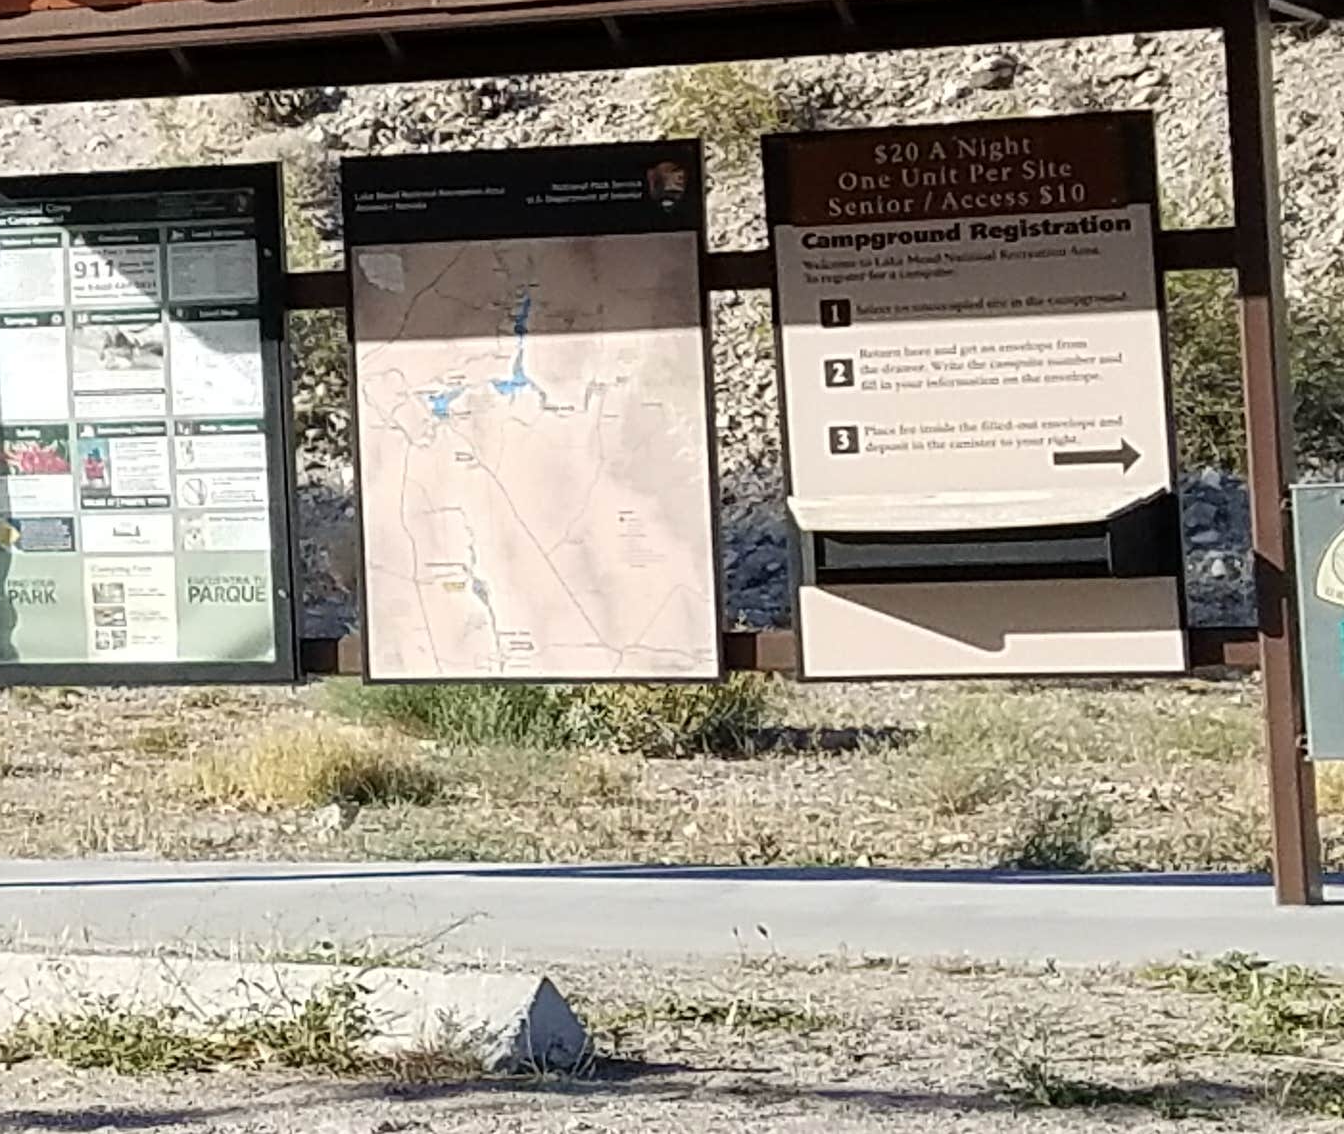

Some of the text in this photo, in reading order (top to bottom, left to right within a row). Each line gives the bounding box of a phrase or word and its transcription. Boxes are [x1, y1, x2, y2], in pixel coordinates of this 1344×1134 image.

[874, 135, 1033, 165] $20 A Night
[838, 159, 1073, 192] One Unit Per Site
[828, 183, 1087, 217] Senior / Access $10
[801, 215, 1132, 252] Campground Registration
[73, 260, 115, 279] 911
[8, 589, 58, 605] PARK
[187, 585, 268, 603] PARQUE
